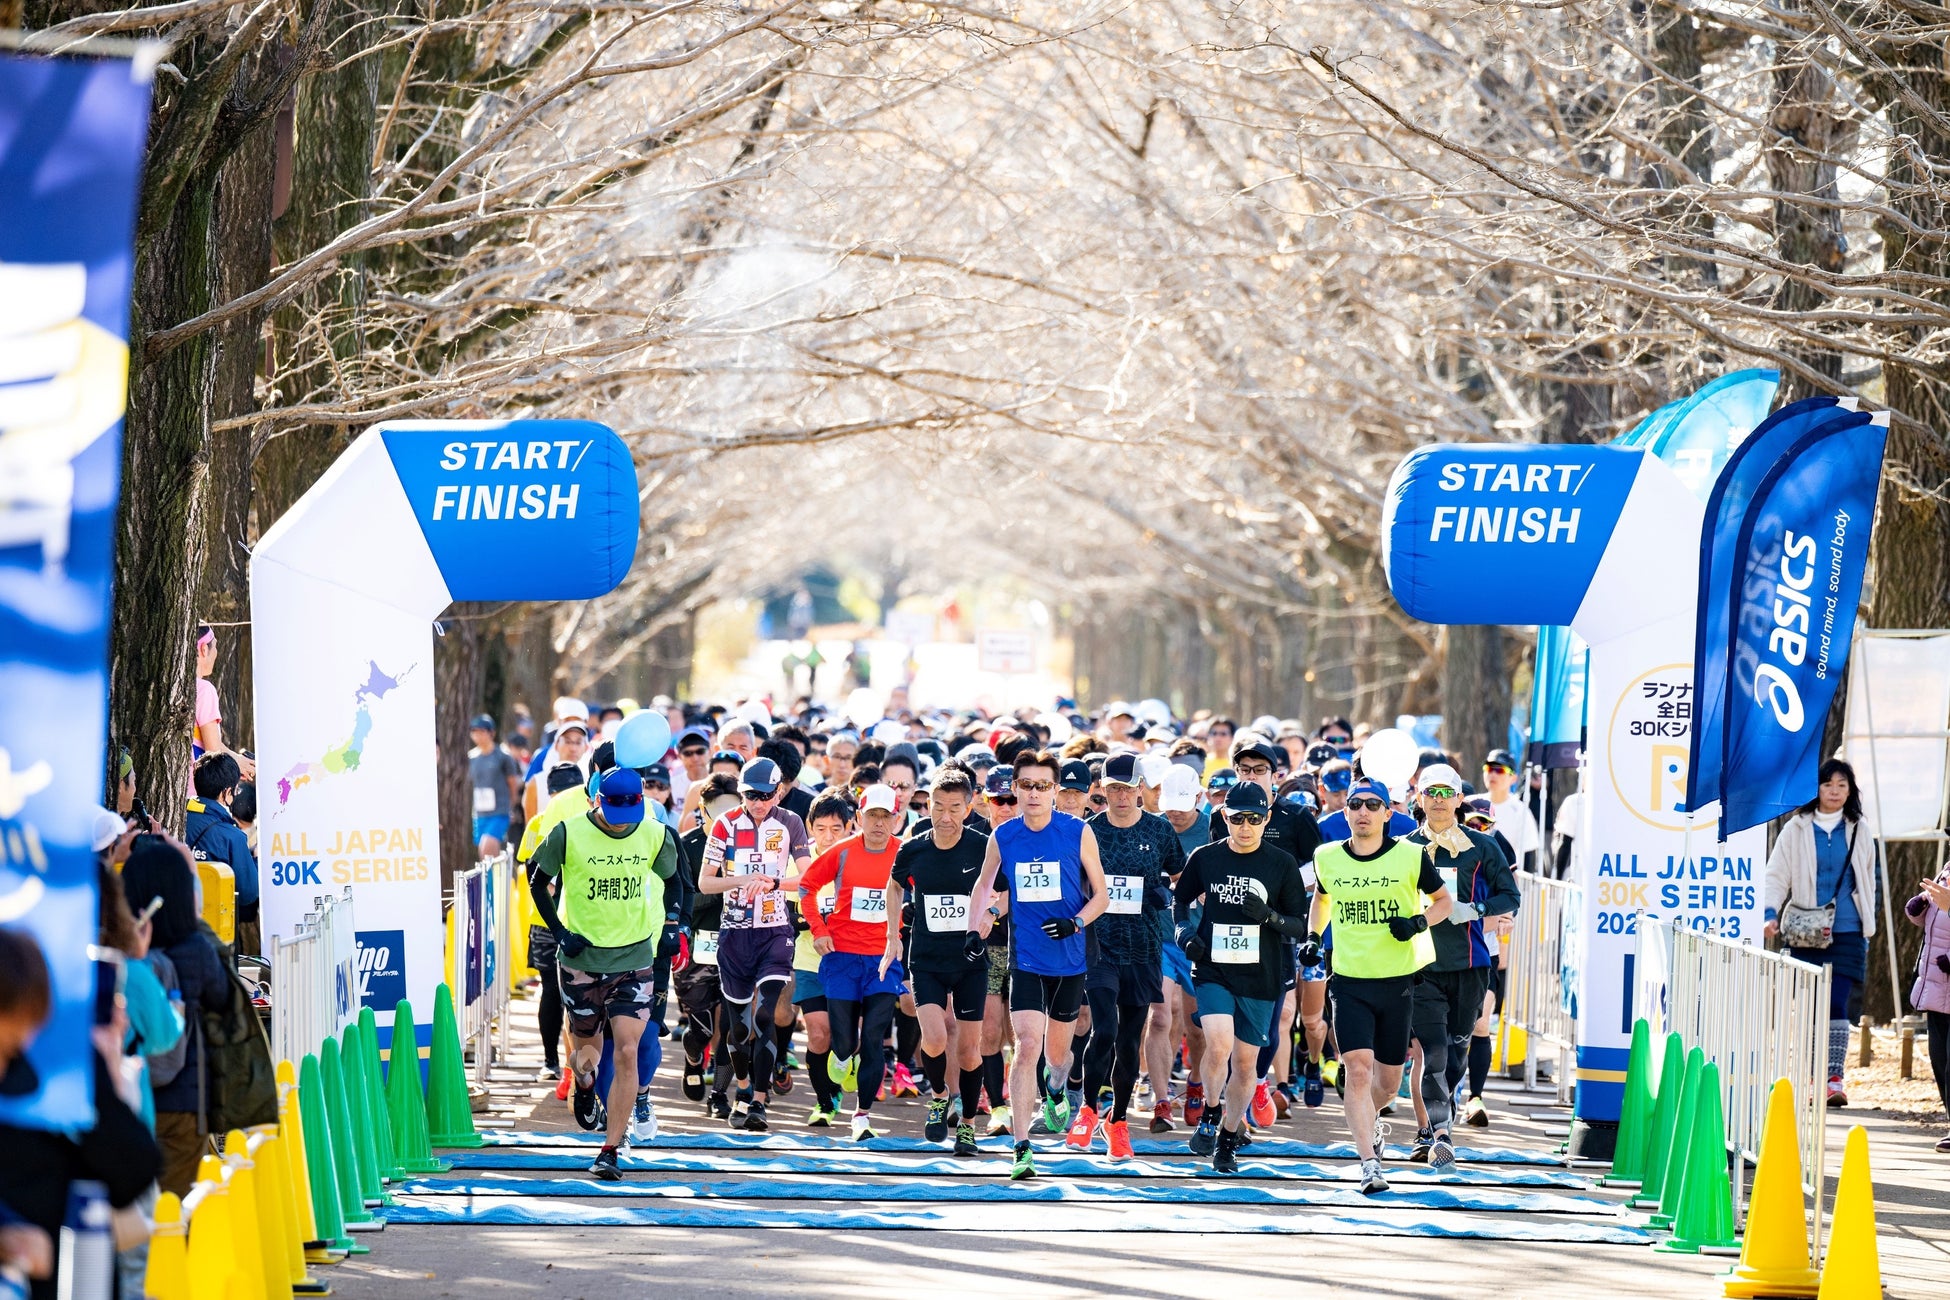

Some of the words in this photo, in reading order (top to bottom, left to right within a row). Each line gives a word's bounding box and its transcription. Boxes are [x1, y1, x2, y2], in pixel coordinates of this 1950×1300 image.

[439, 439, 594, 472] START/
[1437, 462, 1595, 496] START/
[432, 484, 580, 521] FINISH
[1429, 506, 1581, 543] FINISH
[1830, 509, 1850, 547] body
[1829, 546, 1843, 592] sound
[1769, 530, 1816, 666] asics
[1823, 597, 1839, 634] mind,
[1816, 634, 1831, 680] sound
[1630, 721, 1692, 737] 30Kシ
[271, 832, 317, 857] ALL
[326, 828, 423, 855] JAPAN
[272, 860, 322, 886] 30K
[331, 855, 429, 884] SERIES
[587, 854, 648, 865] ペースメーカー
[1598, 853, 1647, 878] ALL
[1656, 855, 1752, 881] JAPAN
[1023, 875, 1050, 888] 213
[1107, 887, 1132, 900] 214
[1226, 875, 1249, 887] THE
[1333, 876, 1400, 887] ペースメーカー
[1597, 881, 1650, 907] 30K
[1660, 884, 1755, 910] SERIES
[861, 899, 886, 911] 278
[930, 906, 966, 919] 2029
[1222, 937, 1249, 950] 184
